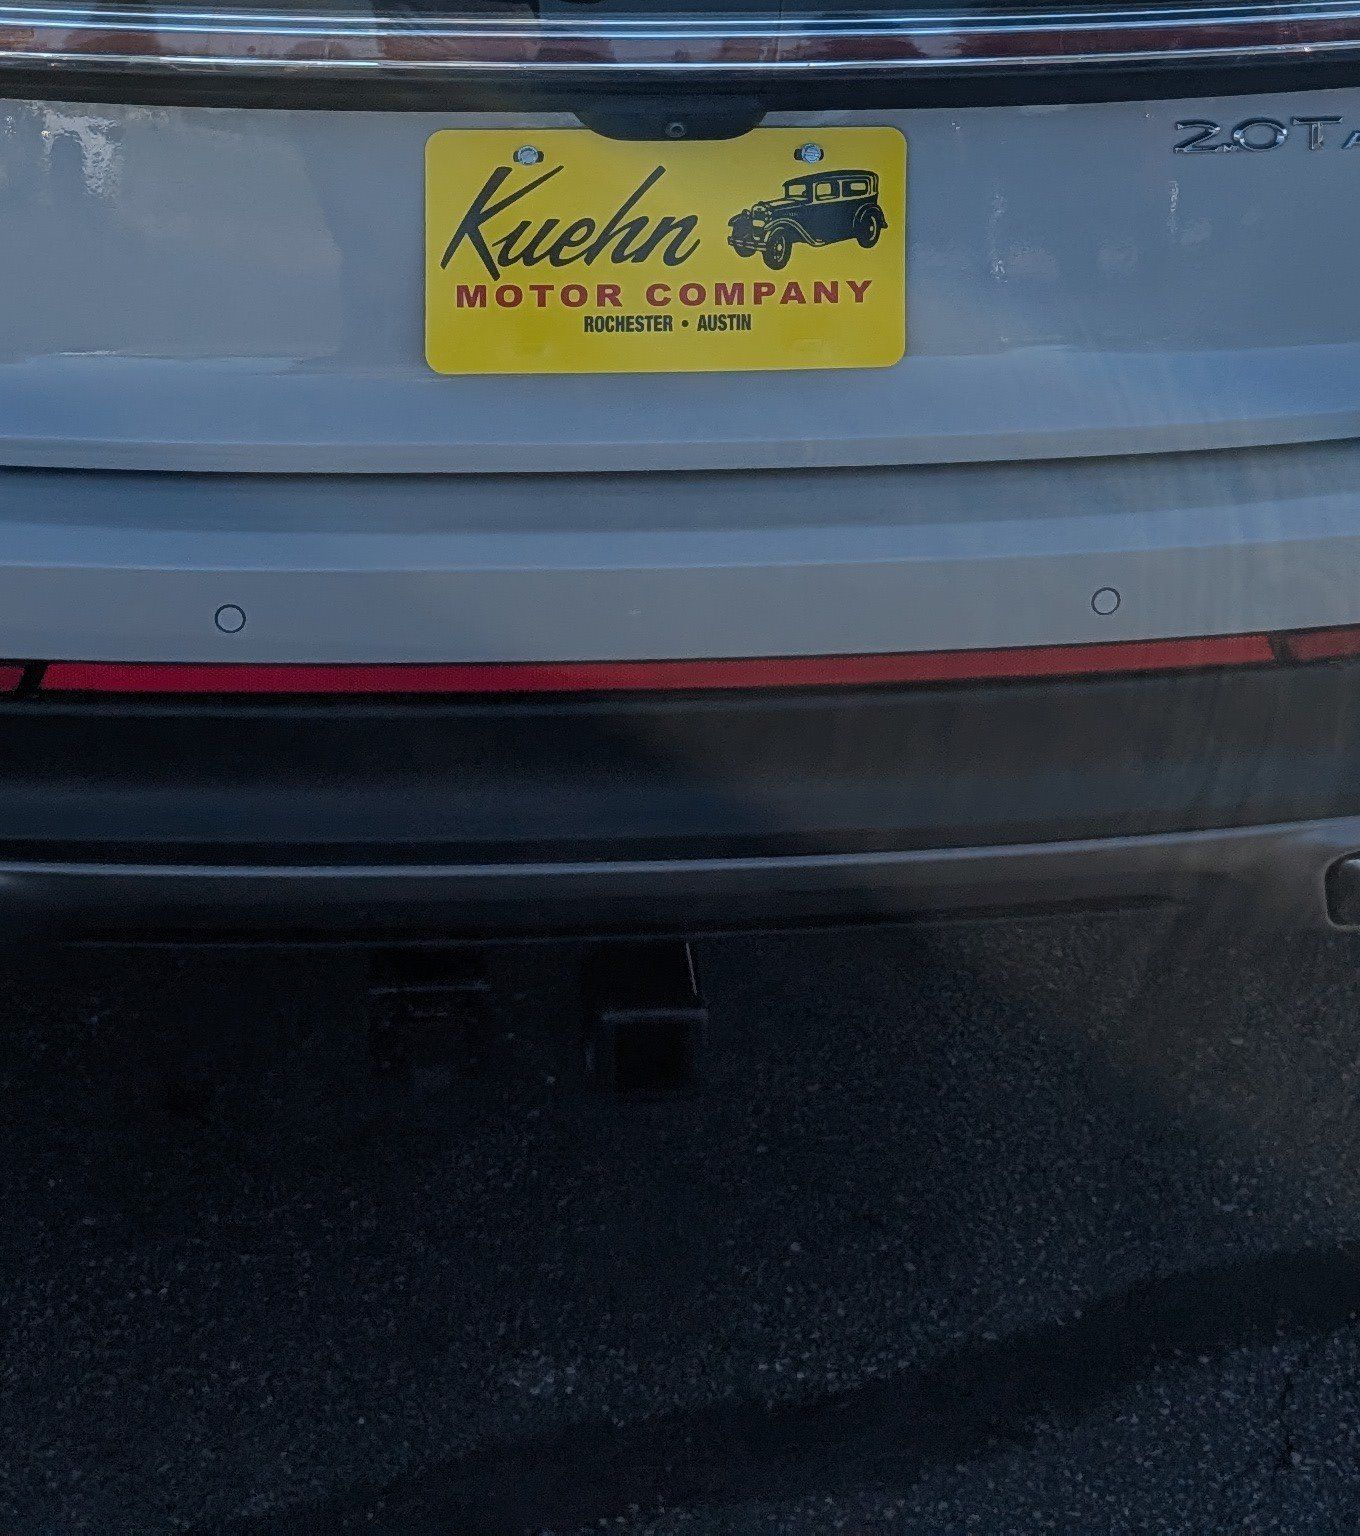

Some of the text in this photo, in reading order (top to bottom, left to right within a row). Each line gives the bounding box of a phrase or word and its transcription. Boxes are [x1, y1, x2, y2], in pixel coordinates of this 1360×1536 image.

[440, 165, 701, 282] Kuehn
[455, 280, 874, 309] MOTOR COMPANY
[583, 313, 752, 334] ROCHESTER AUSTIN
